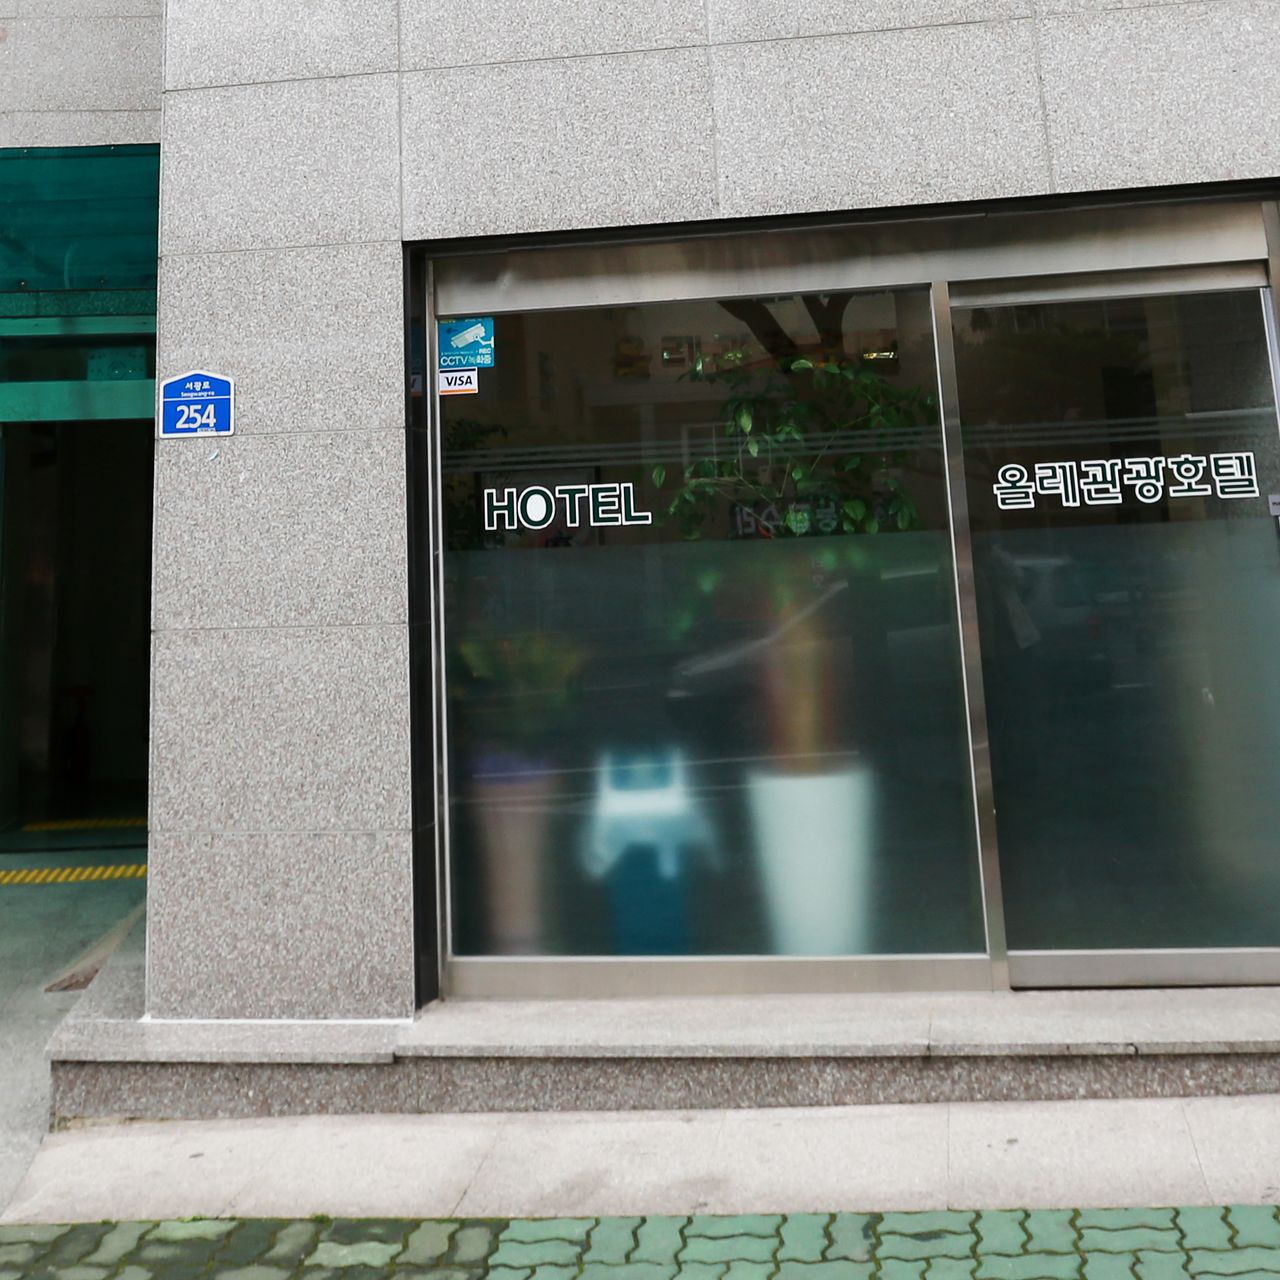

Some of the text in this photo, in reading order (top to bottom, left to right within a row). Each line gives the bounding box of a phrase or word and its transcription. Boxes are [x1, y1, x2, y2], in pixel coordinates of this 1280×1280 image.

[184, 380, 211, 391] 서광로
[445, 375, 473, 387] VISA
[175, 403, 217, 429] 254
[992, 451, 1261, 510] 올레관광호텔
[483, 482, 653, 531] HOTEL
